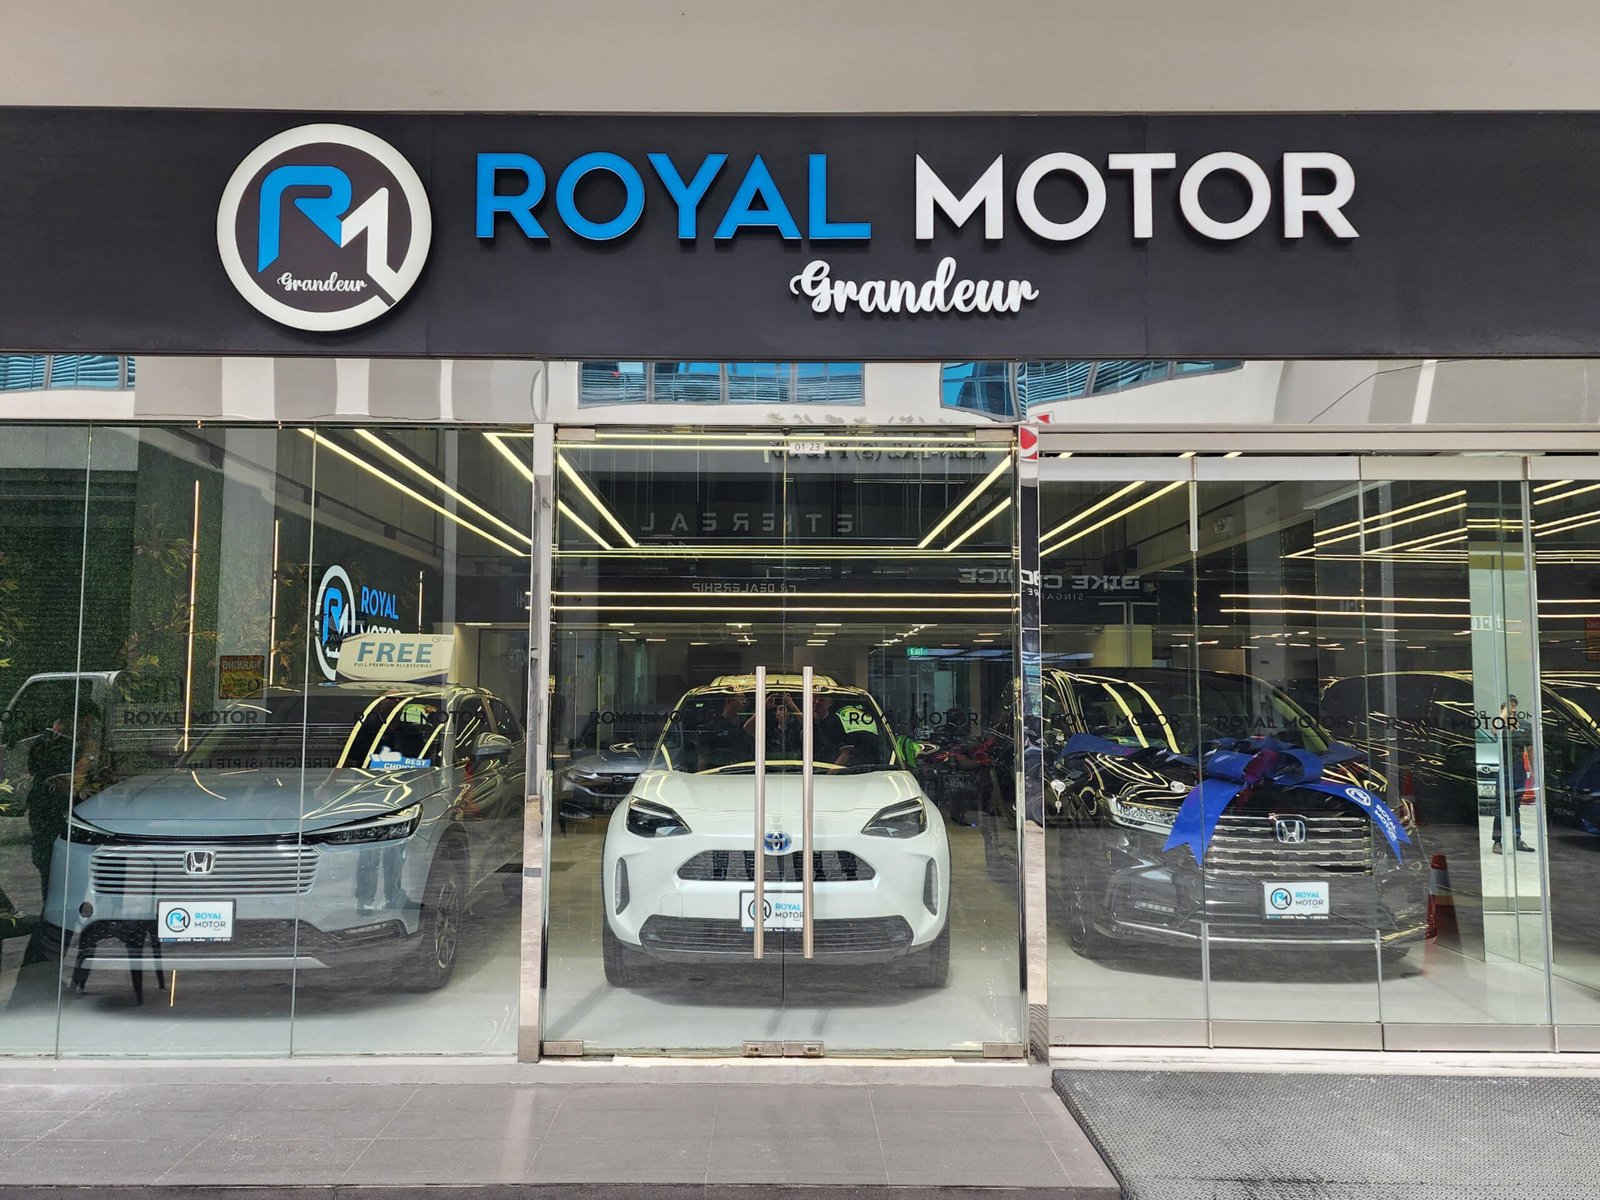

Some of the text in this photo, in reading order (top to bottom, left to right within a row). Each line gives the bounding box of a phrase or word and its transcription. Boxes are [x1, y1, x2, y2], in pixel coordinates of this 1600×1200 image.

[475, 150, 1361, 242] ROYAL MOTOR
[276, 271, 368, 292] Grandeur
[789, 256, 1040, 314] Grandeur
[360, 585, 399, 620] ROYAL
[357, 641, 433, 663] FREE
[123, 710, 258, 725] ROYAL MOTOR
[405, 758, 427, 767] BEST
[194, 912, 223, 920] ROYAL
[775, 903, 801, 911] ROYAL
[194, 920, 226, 928] MOTOR
